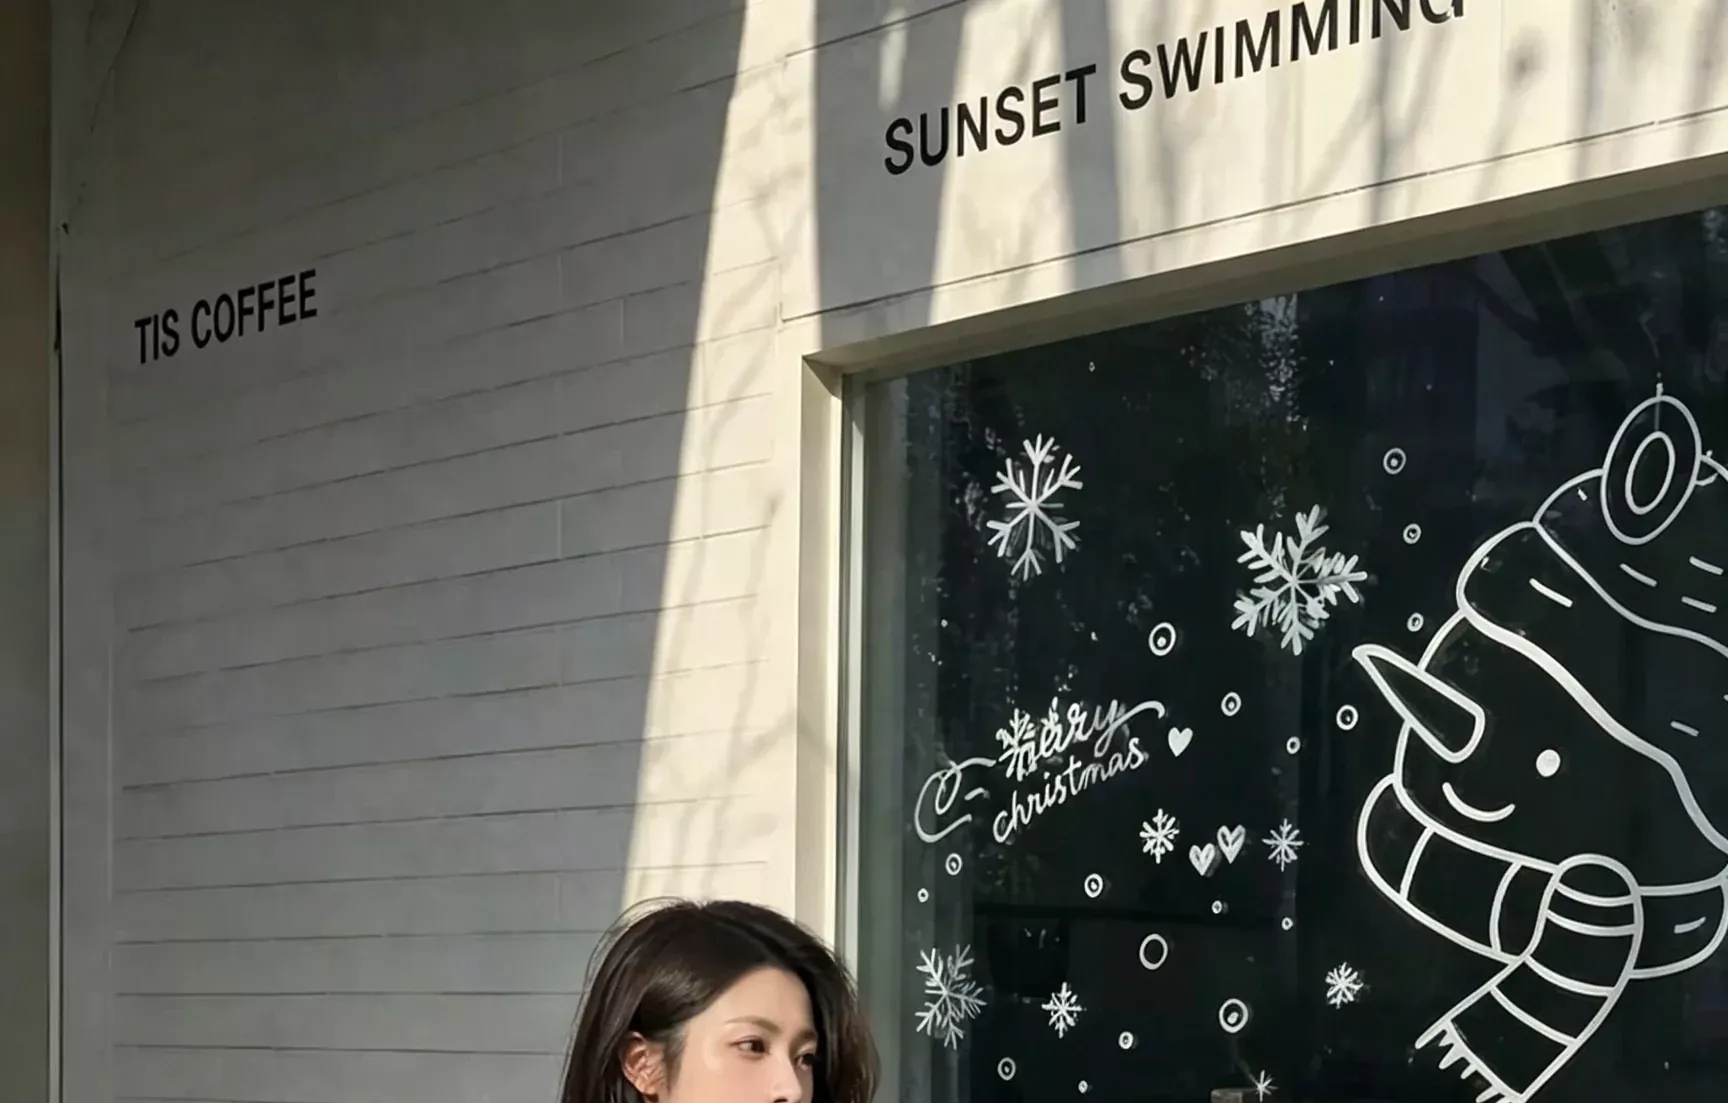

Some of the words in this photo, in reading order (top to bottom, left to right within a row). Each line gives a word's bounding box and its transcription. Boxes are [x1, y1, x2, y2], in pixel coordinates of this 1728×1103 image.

[884, 63, 1097, 176] SUNSET
[134, 308, 180, 364] TIS
[191, 268, 318, 349] COFFEE
